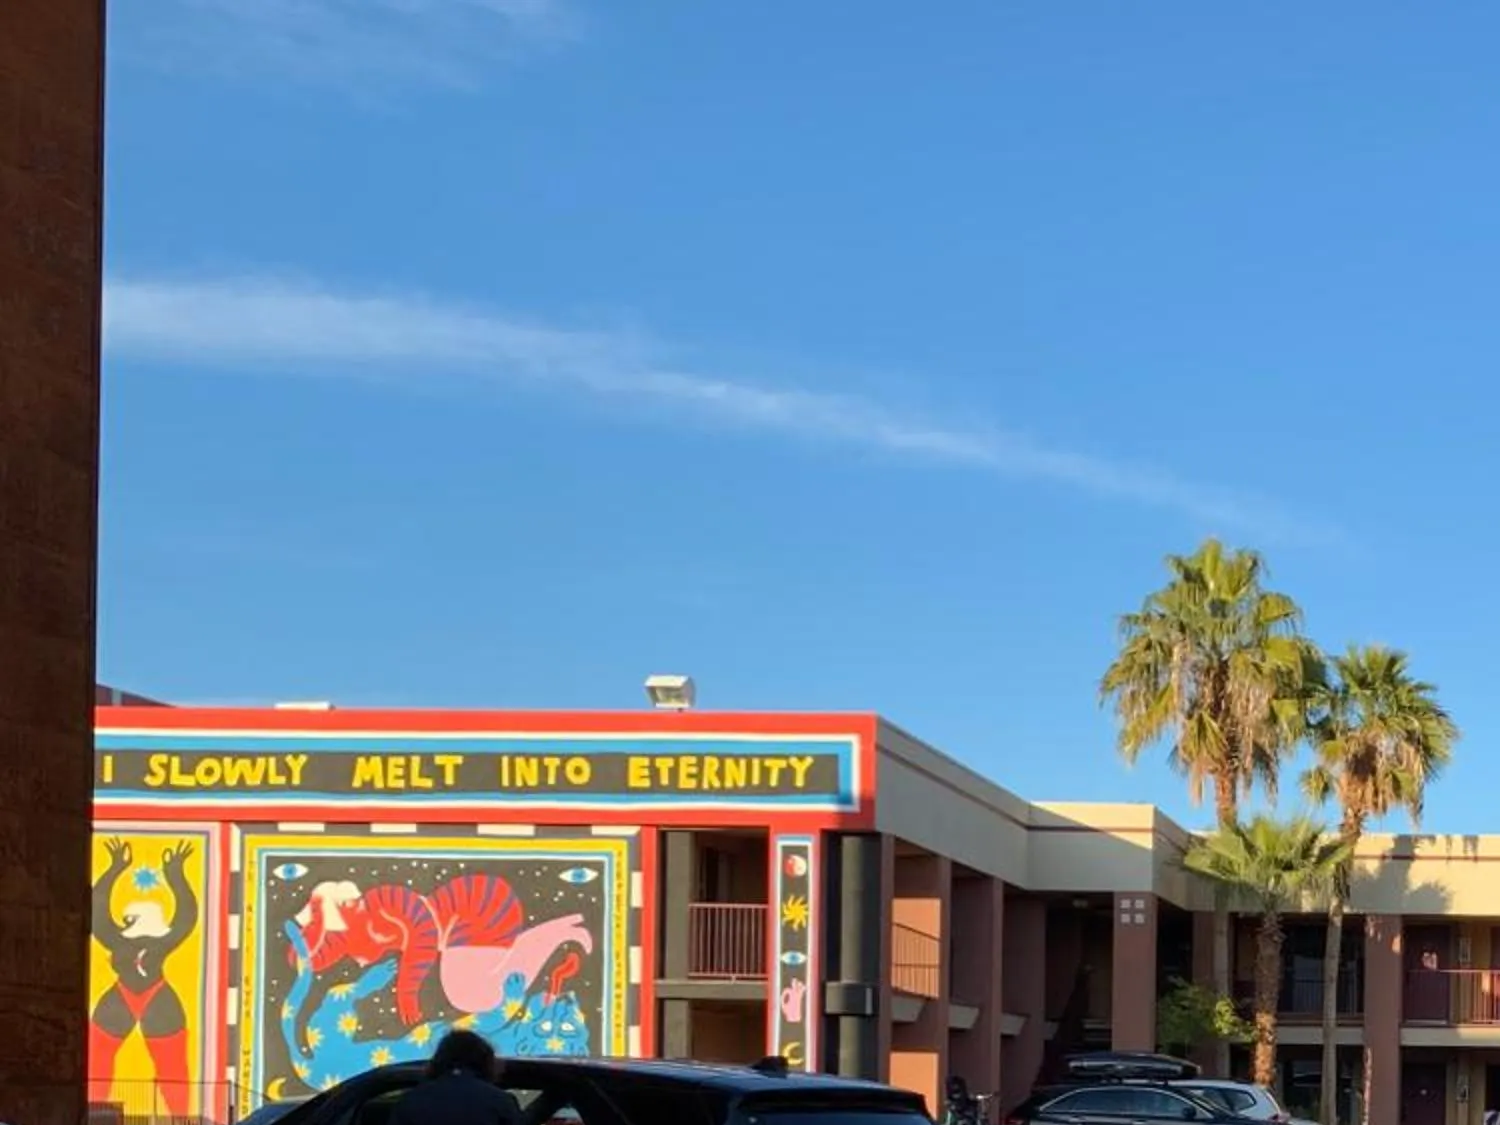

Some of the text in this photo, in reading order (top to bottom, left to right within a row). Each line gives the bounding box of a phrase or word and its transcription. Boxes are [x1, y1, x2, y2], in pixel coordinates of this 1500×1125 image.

[103, 753, 814, 789] I SLOWLY MELT INTO ETERNITY
